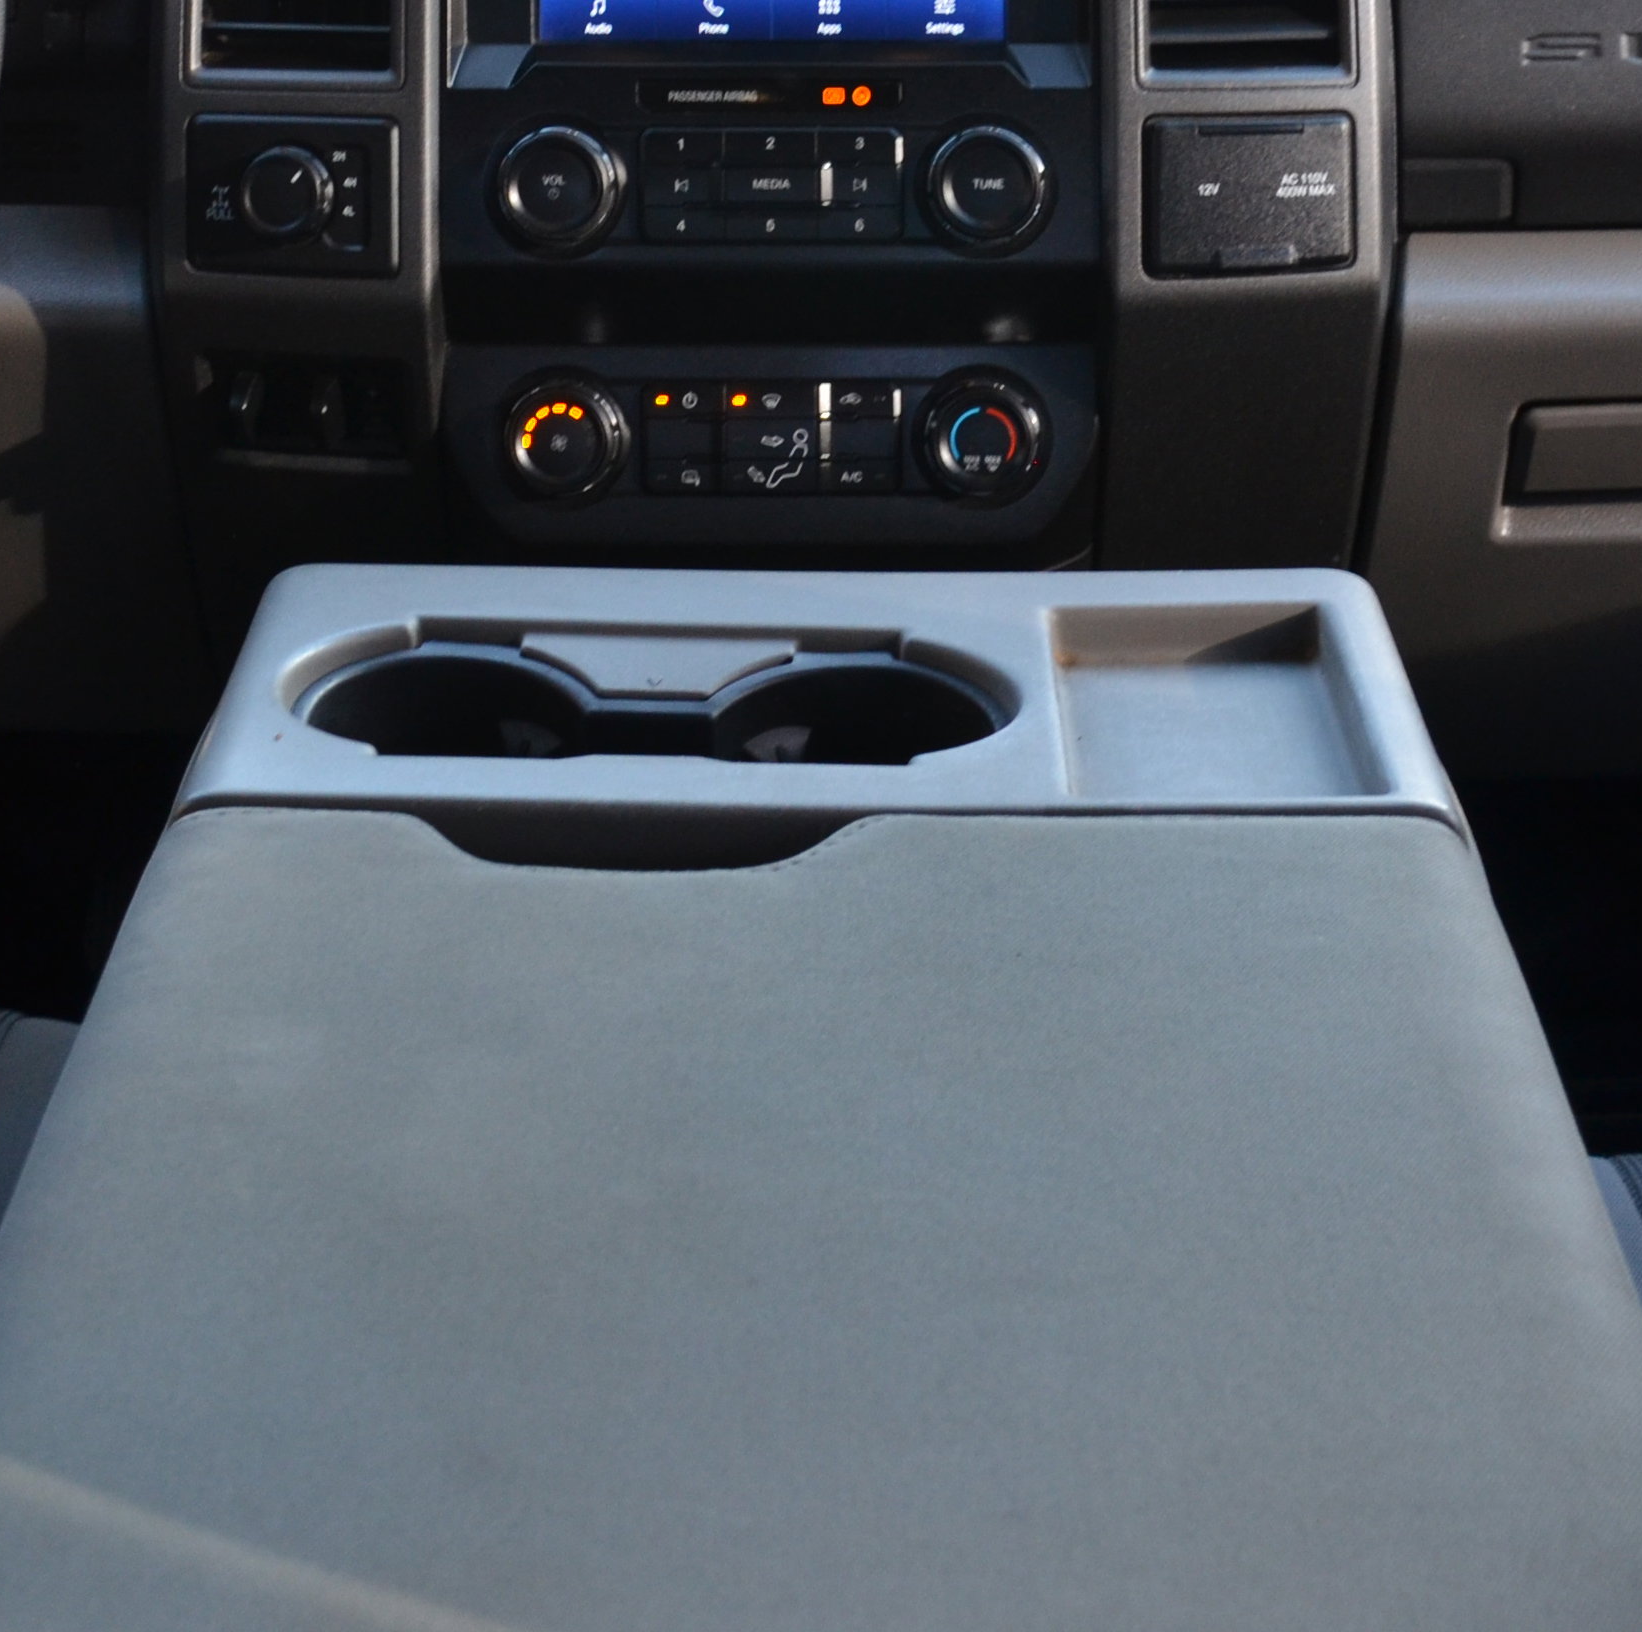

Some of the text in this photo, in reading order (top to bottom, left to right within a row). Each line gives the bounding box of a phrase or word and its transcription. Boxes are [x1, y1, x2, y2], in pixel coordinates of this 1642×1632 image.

[583, 21, 614, 36] Audio
[697, 21, 730, 36] Phone
[816, 21, 843, 37] Apps
[924, 20, 966, 37] Settings
[667, 89, 758, 103] PASSENGER AIRBAG
[676, 136, 686, 152] 1
[764, 135, 777, 151] 2
[854, 135, 866, 151] 3
[541, 173, 566, 187] VOL
[751, 177, 792, 191] MEDIA
[971, 177, 1006, 191] TUNE
[1280, 172, 1300, 186] AC
[1197, 182, 1221, 197] 12V
[1308, 183, 1336, 197] MAX
[675, 218, 686, 233] 4
[764, 217, 777, 233] 5
[853, 217, 866, 233] 6
[839, 470, 864, 484] A/C
